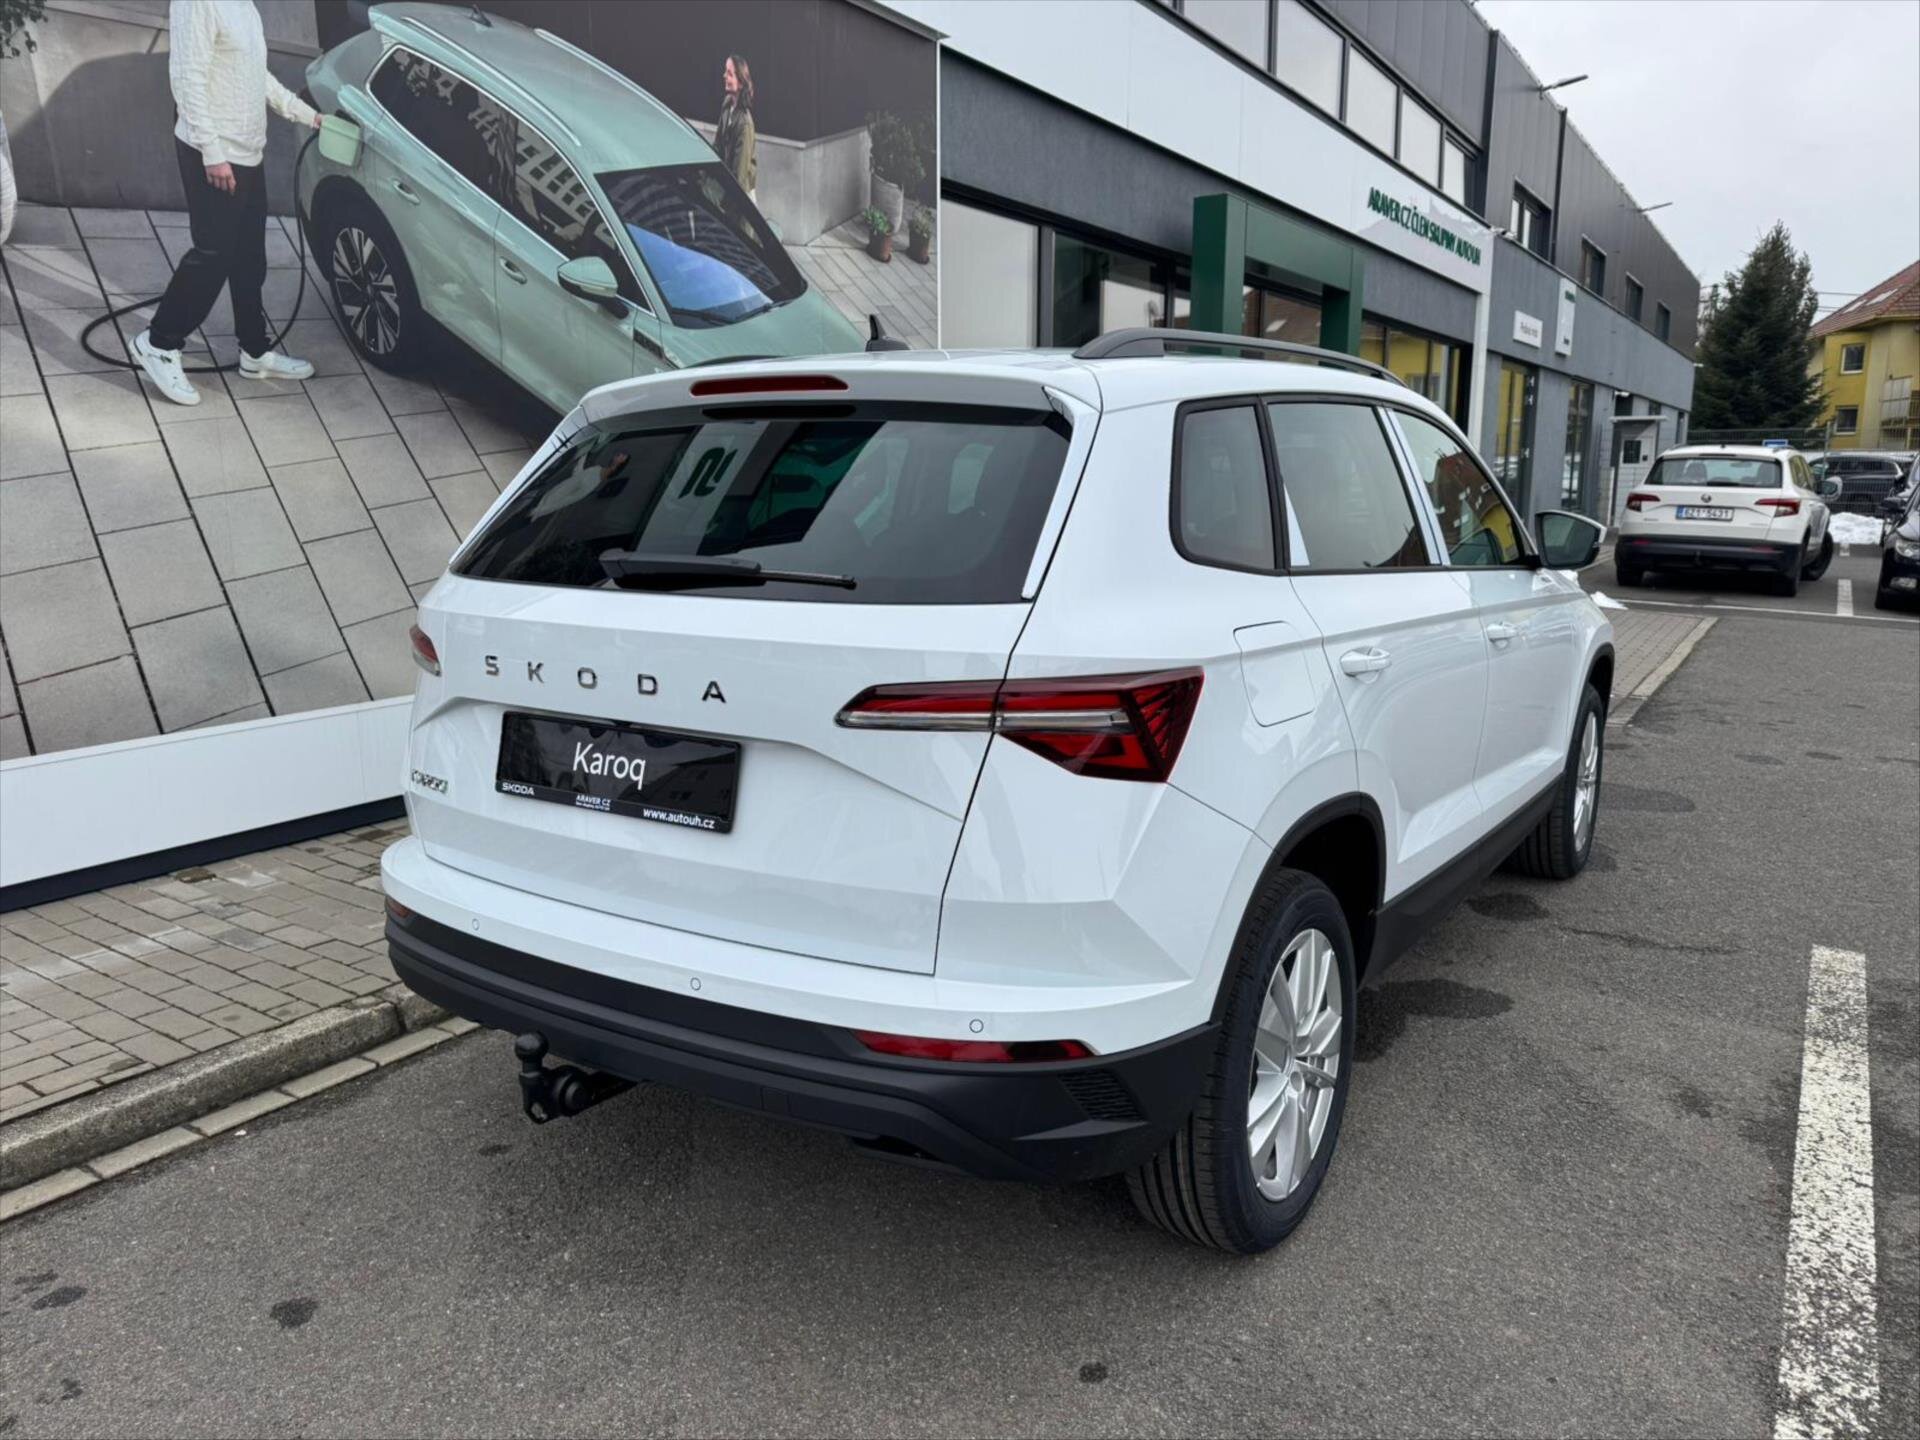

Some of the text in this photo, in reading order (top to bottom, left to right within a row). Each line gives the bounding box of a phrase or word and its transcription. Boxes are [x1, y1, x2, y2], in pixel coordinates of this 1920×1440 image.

[485, 655, 726, 704] SKODA
[573, 742, 646, 790] Karoq
[643, 808, 715, 829] www.autouh.cz
